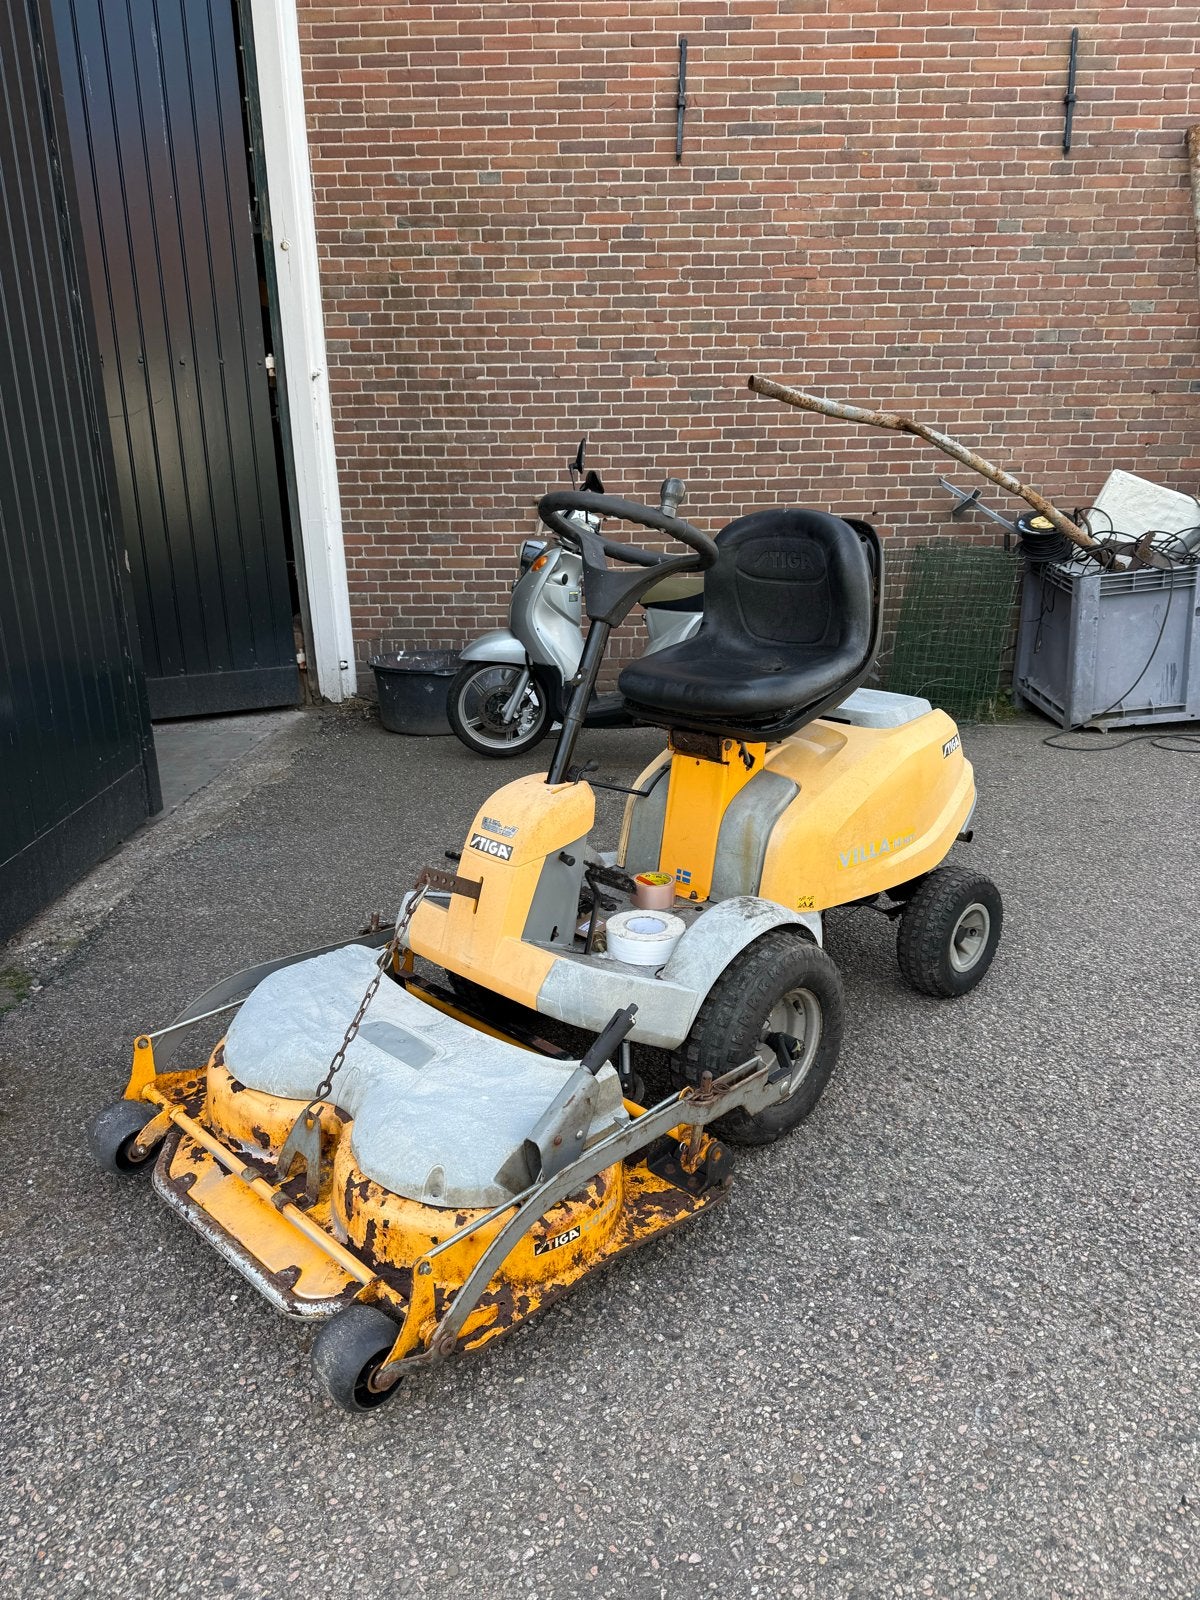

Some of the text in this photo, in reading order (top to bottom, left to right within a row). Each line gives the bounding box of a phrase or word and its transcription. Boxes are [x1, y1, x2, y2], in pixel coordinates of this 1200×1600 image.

[754, 551, 814, 569] STIGA
[470, 836, 510, 860] STIGA
[839, 836, 891, 868] VILLA
